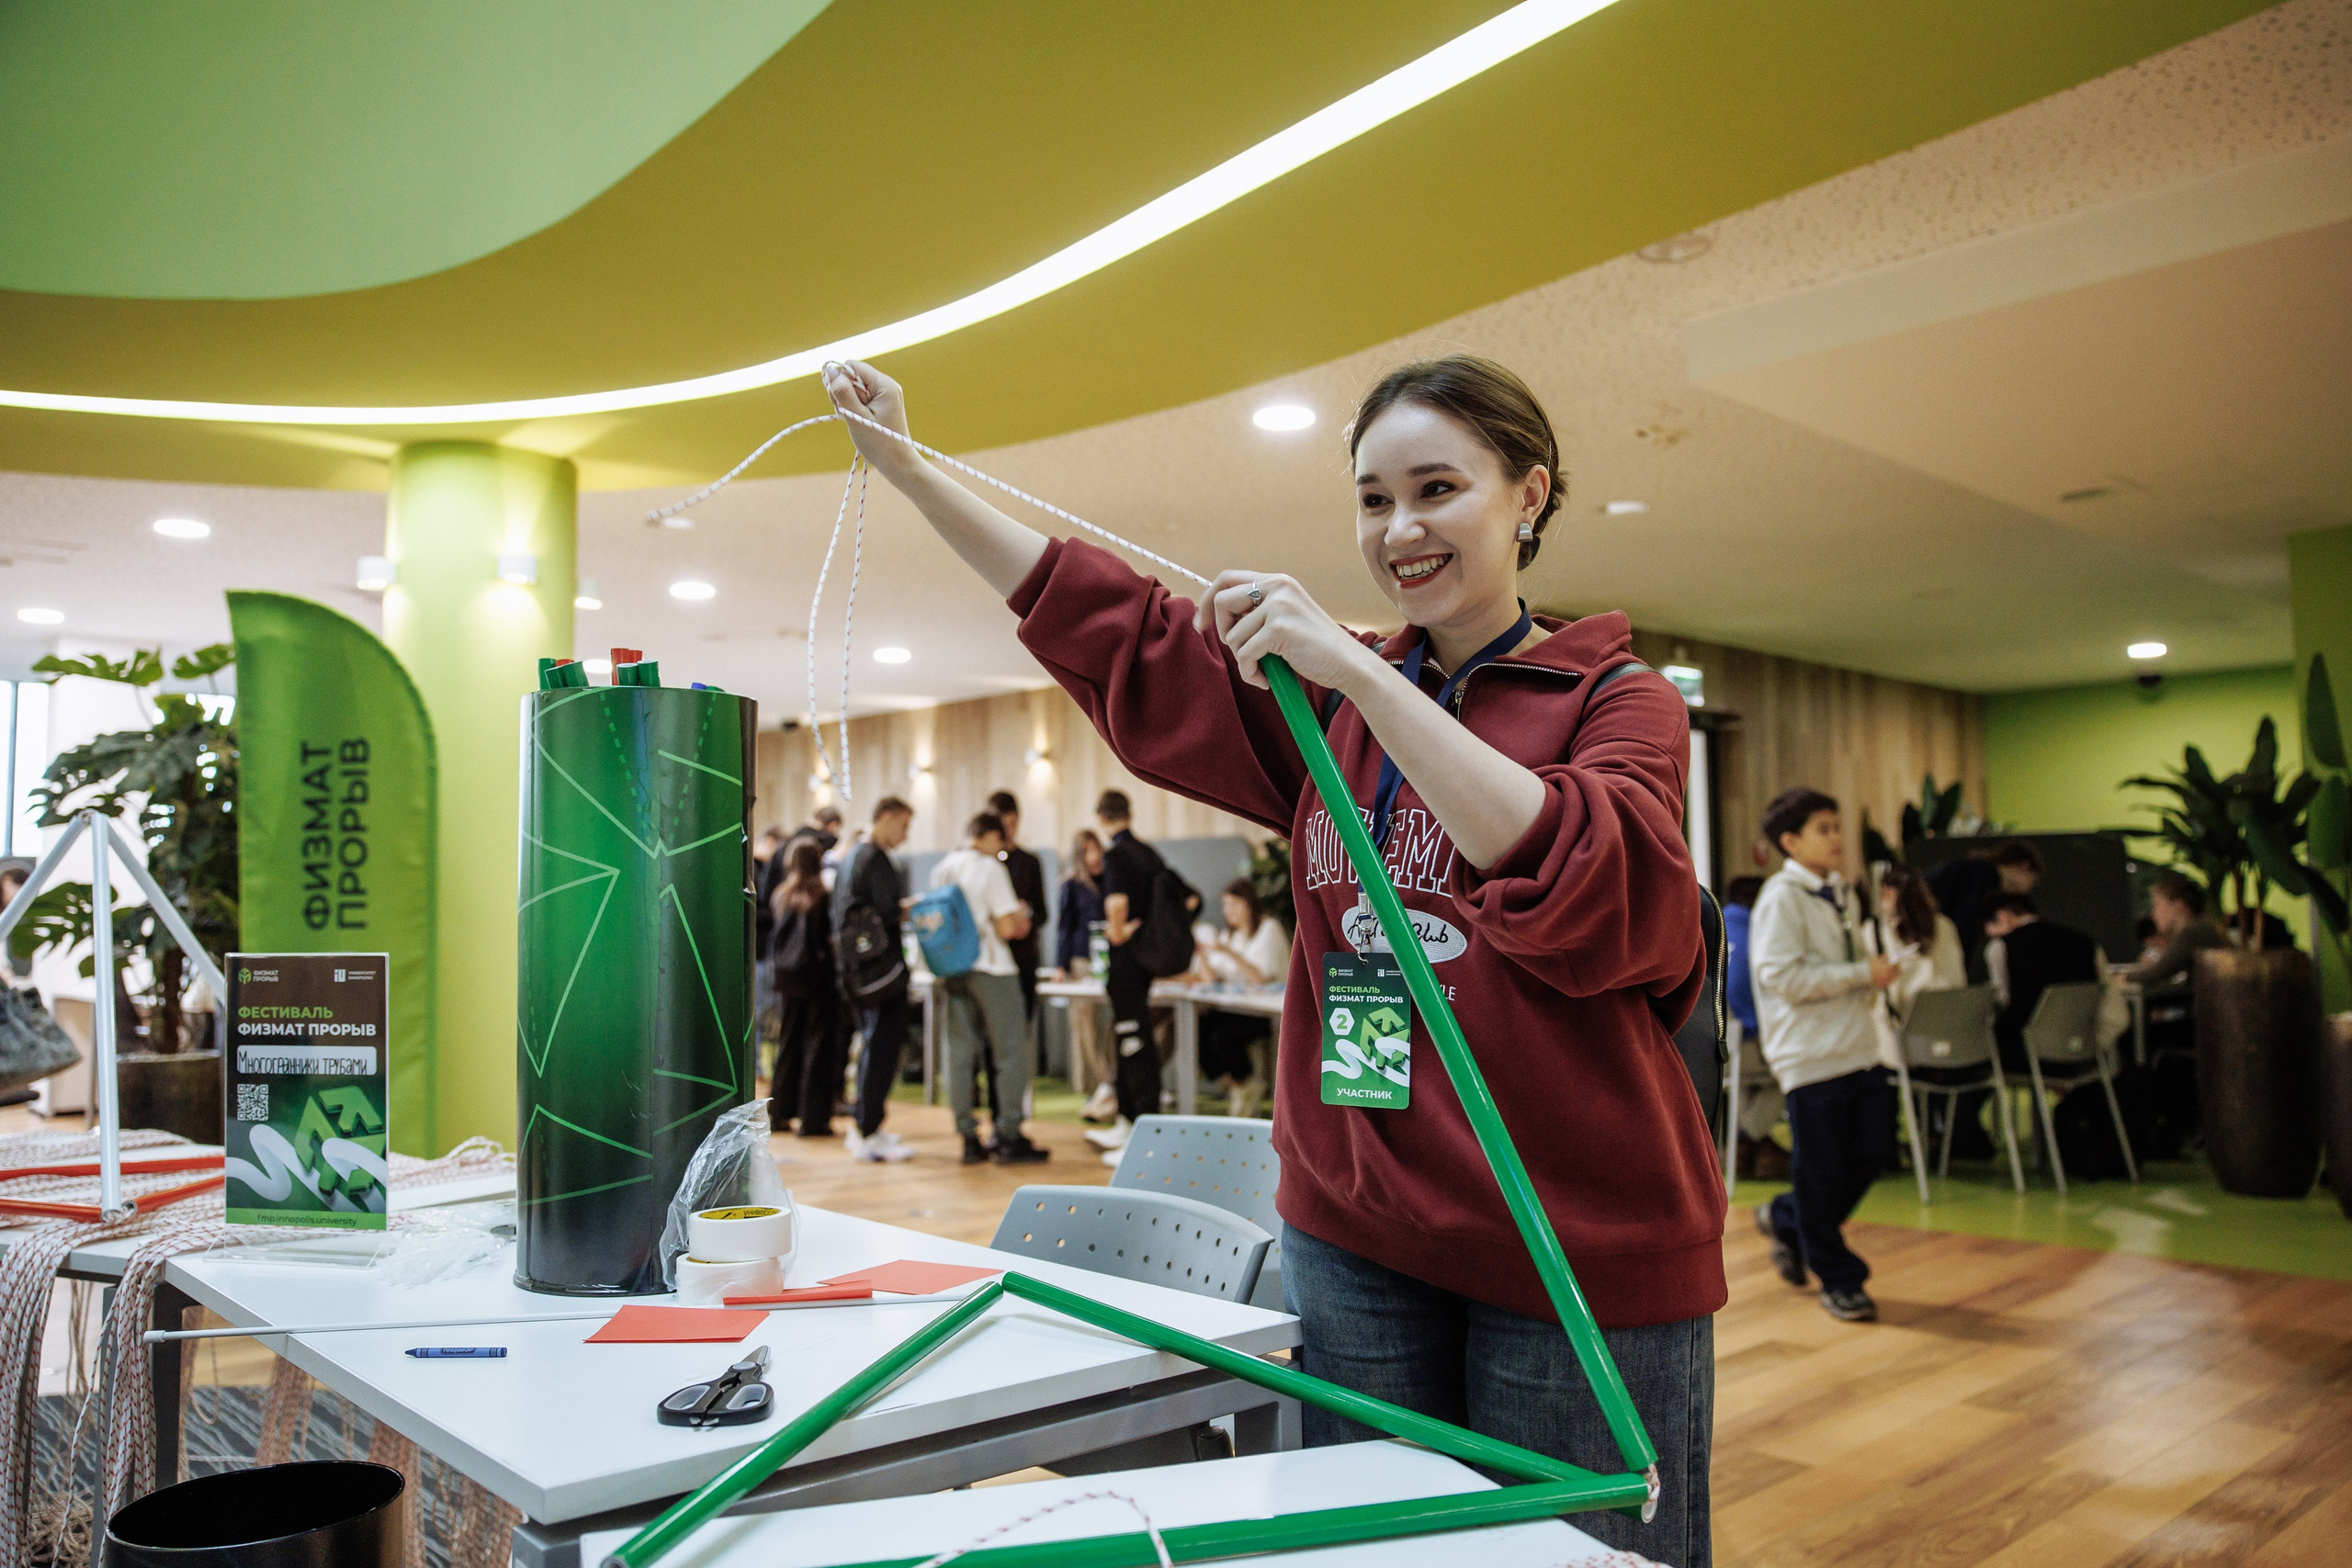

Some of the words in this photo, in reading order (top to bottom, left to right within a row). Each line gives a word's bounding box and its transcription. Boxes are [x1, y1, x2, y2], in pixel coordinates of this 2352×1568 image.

[300, 740, 332, 931] ФИЗМАТ
[337, 738, 369, 930] ПРОРЫВ
[1329, 985, 1381, 994] ФЕСТИВАЛЬ
[1329, 994, 1365, 1003] ФИЗМАТ
[1366, 995, 1404, 1004] ПРОРЫВ
[237, 1006, 334, 1020] ФЕСТИВАЛЬ
[1336, 1013, 1348, 1030] 2
[237, 1022, 305, 1036] ФИЗМАТ
[309, 1023, 377, 1037] ПРОРЫВ
[1337, 1088, 1393, 1100] УЧАСТНИК
[257, 1213, 357, 1227] fmp.innopolis.university
